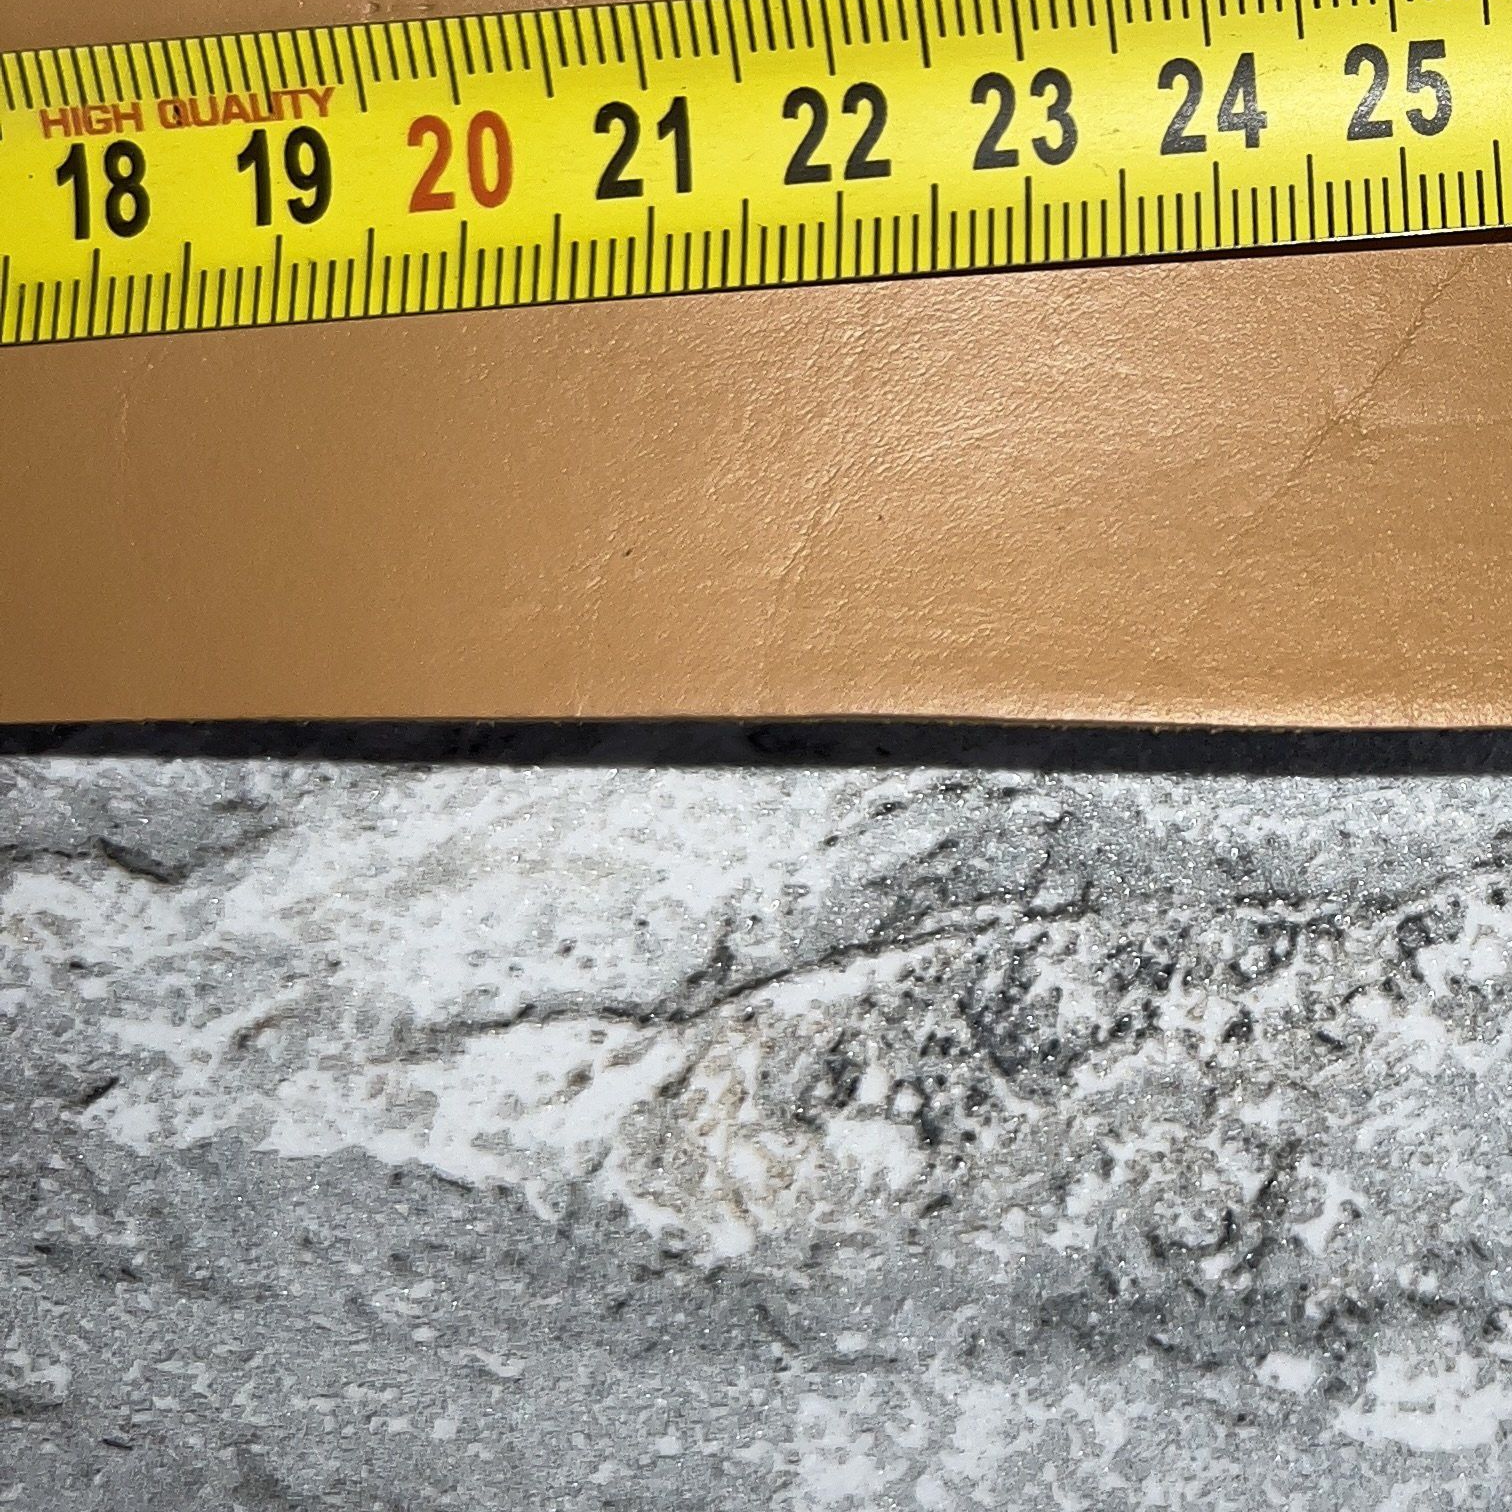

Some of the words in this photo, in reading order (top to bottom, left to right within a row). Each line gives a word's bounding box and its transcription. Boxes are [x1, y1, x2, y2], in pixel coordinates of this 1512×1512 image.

[40, 103, 142, 138] HIGH
[158, 87, 333, 128] QUALITY
[56, 140, 149, 240] 18
[237, 126, 331, 226] 19
[408, 111, 511, 212] 20
[594, 96, 691, 200] 21
[783, 82, 890, 185] 22
[972, 68, 1077, 170] 23
[1158, 53, 1268, 155] 24
[1345, 39, 1451, 140] 25
